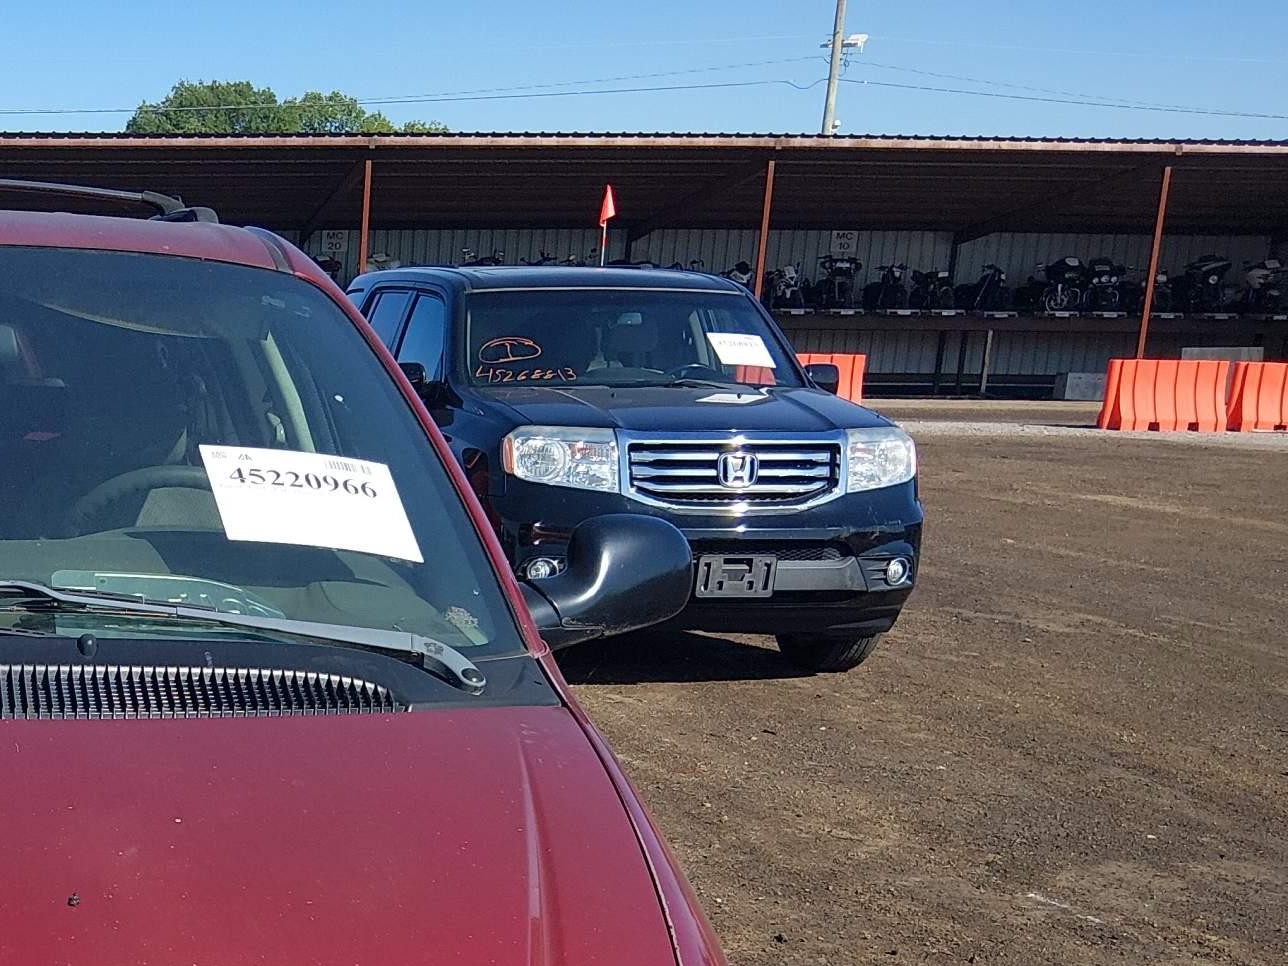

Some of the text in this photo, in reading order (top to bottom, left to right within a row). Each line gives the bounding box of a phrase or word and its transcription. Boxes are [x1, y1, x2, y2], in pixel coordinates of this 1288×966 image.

[326, 231, 343, 240] MC
[836, 231, 853, 241] MC
[327, 241, 342, 250] 20
[839, 241, 850, 250] 10
[475, 366, 577, 383] 45268813
[229, 467, 378, 499] 45220966
